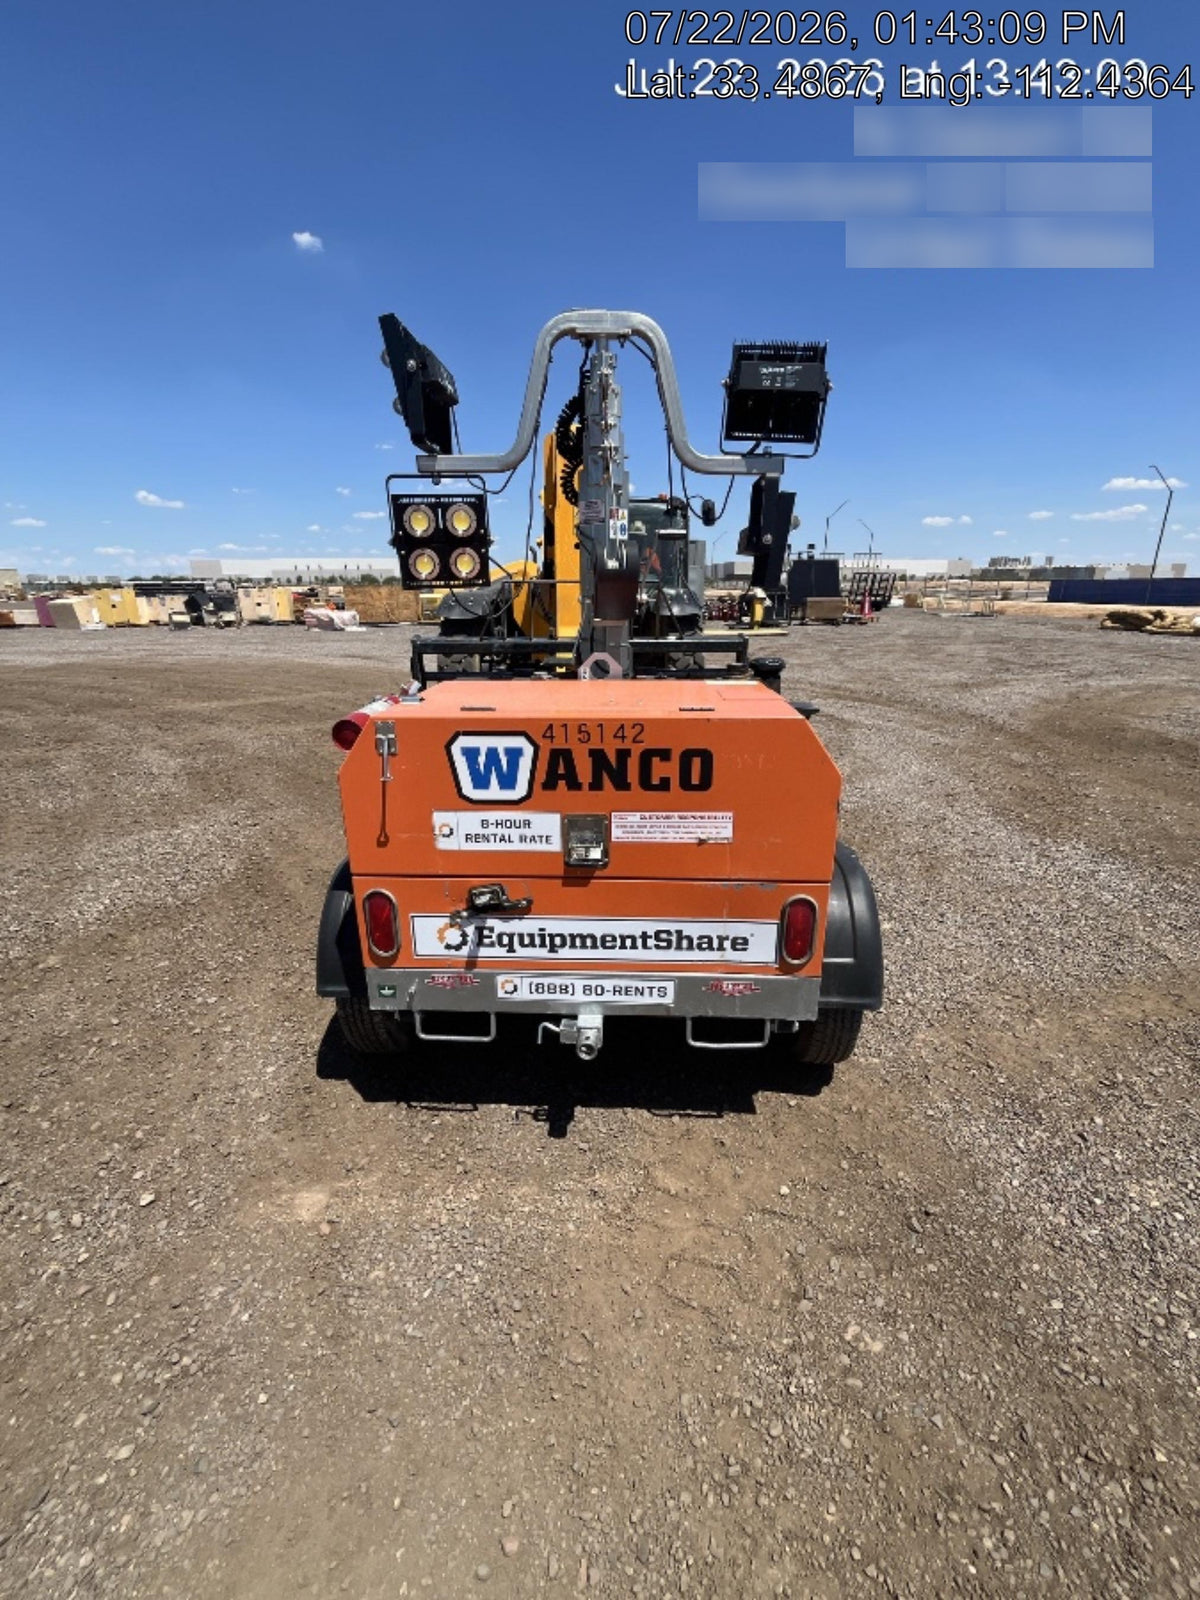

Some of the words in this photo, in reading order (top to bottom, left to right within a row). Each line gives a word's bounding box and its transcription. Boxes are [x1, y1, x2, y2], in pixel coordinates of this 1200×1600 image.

[541, 723, 645, 744] 415142
[459, 746, 714, 792] WANCO
[481, 819, 532, 829] 8-HOUR
[465, 833, 514, 843] RENTAL
[519, 835, 553, 845] RATE
[475, 925, 750, 954] EquipmentShare
[582, 984, 668, 998] 80-RENTS
